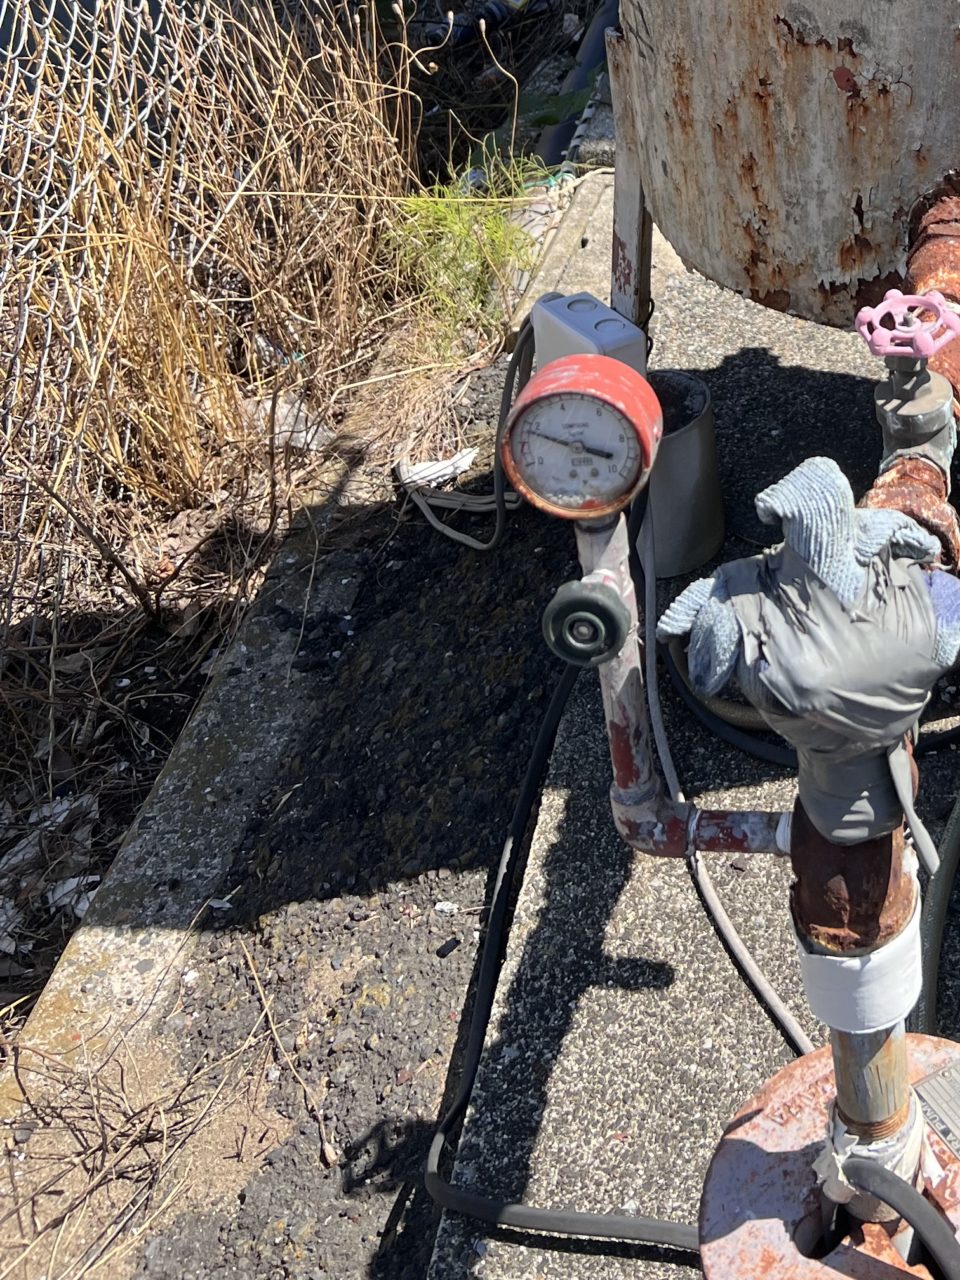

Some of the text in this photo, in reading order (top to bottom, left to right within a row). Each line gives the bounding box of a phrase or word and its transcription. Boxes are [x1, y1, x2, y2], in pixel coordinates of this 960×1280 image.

[560, 403, 565, 411] 4
[535, 422, 540, 431] 2
[607, 463, 618, 473] 10
